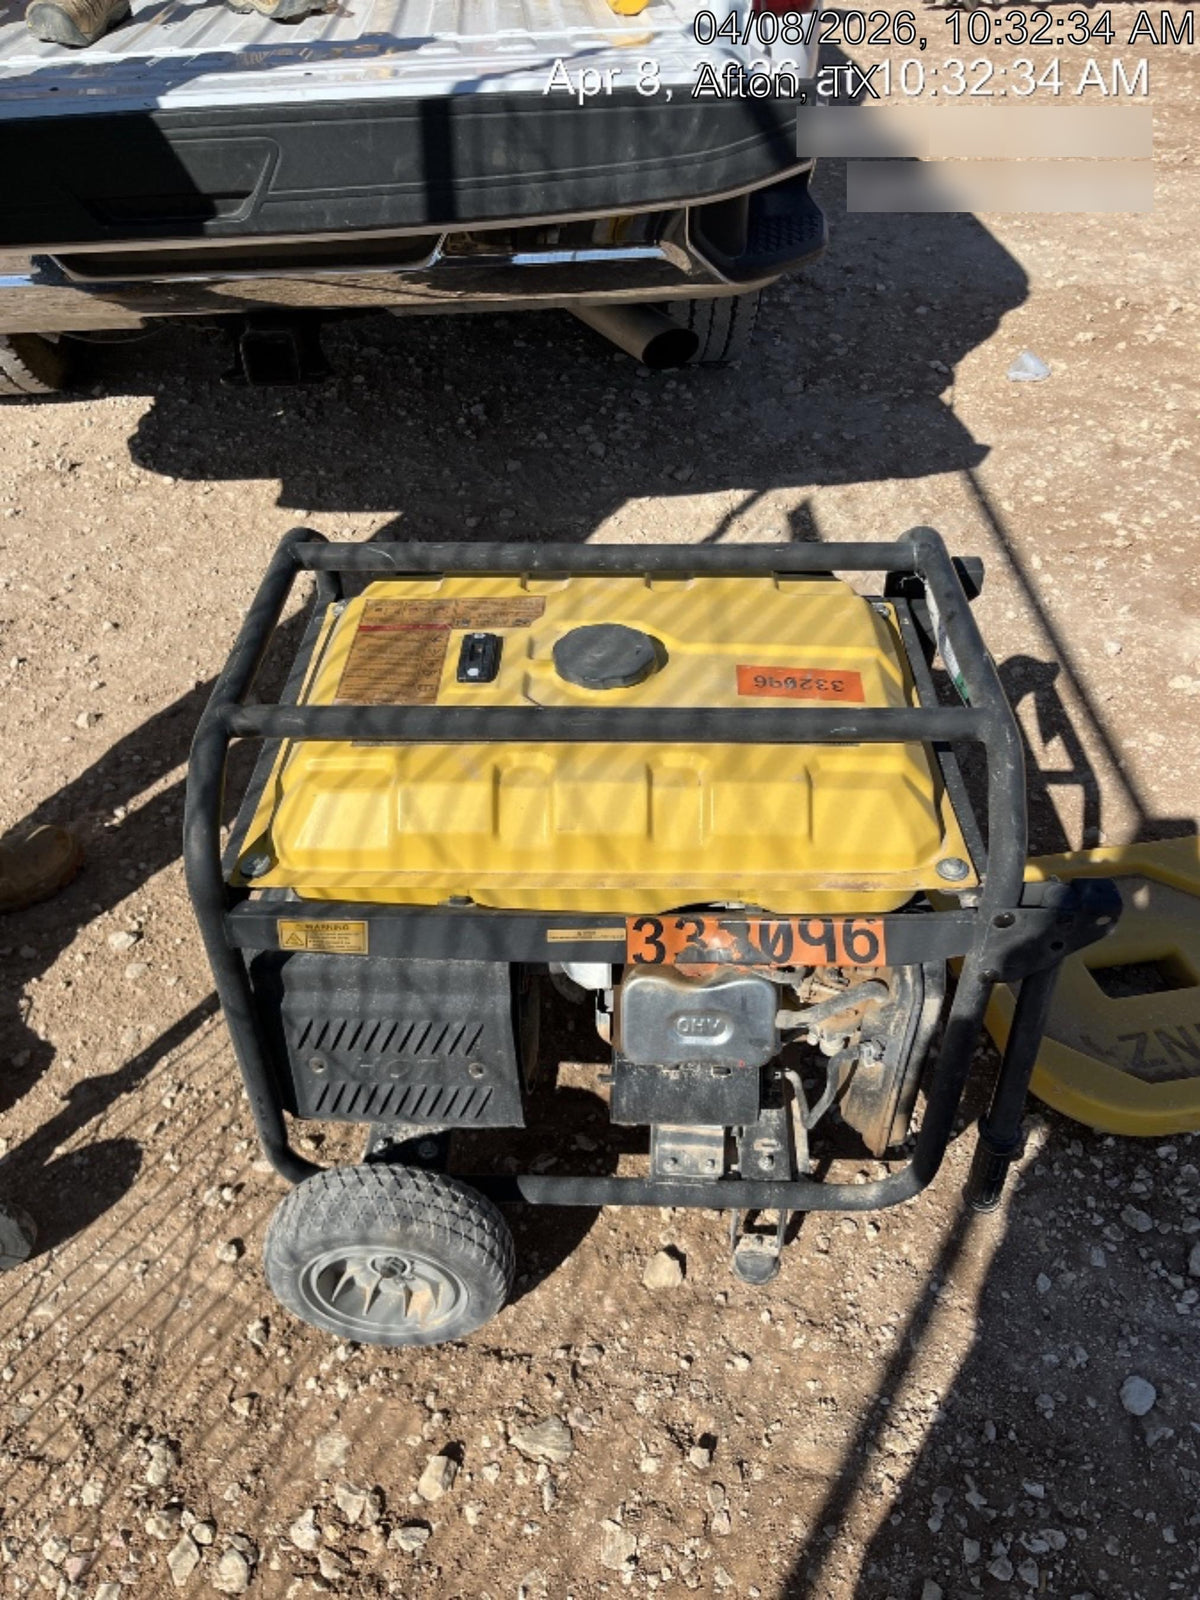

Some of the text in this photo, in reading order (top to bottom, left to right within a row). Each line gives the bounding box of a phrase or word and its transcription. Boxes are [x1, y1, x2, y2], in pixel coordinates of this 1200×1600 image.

[754, 674, 844, 692] 332096
[304, 922, 350, 932] WARNING
[632, 916, 879, 965] 33096
[676, 1016, 721, 1034] OHV
